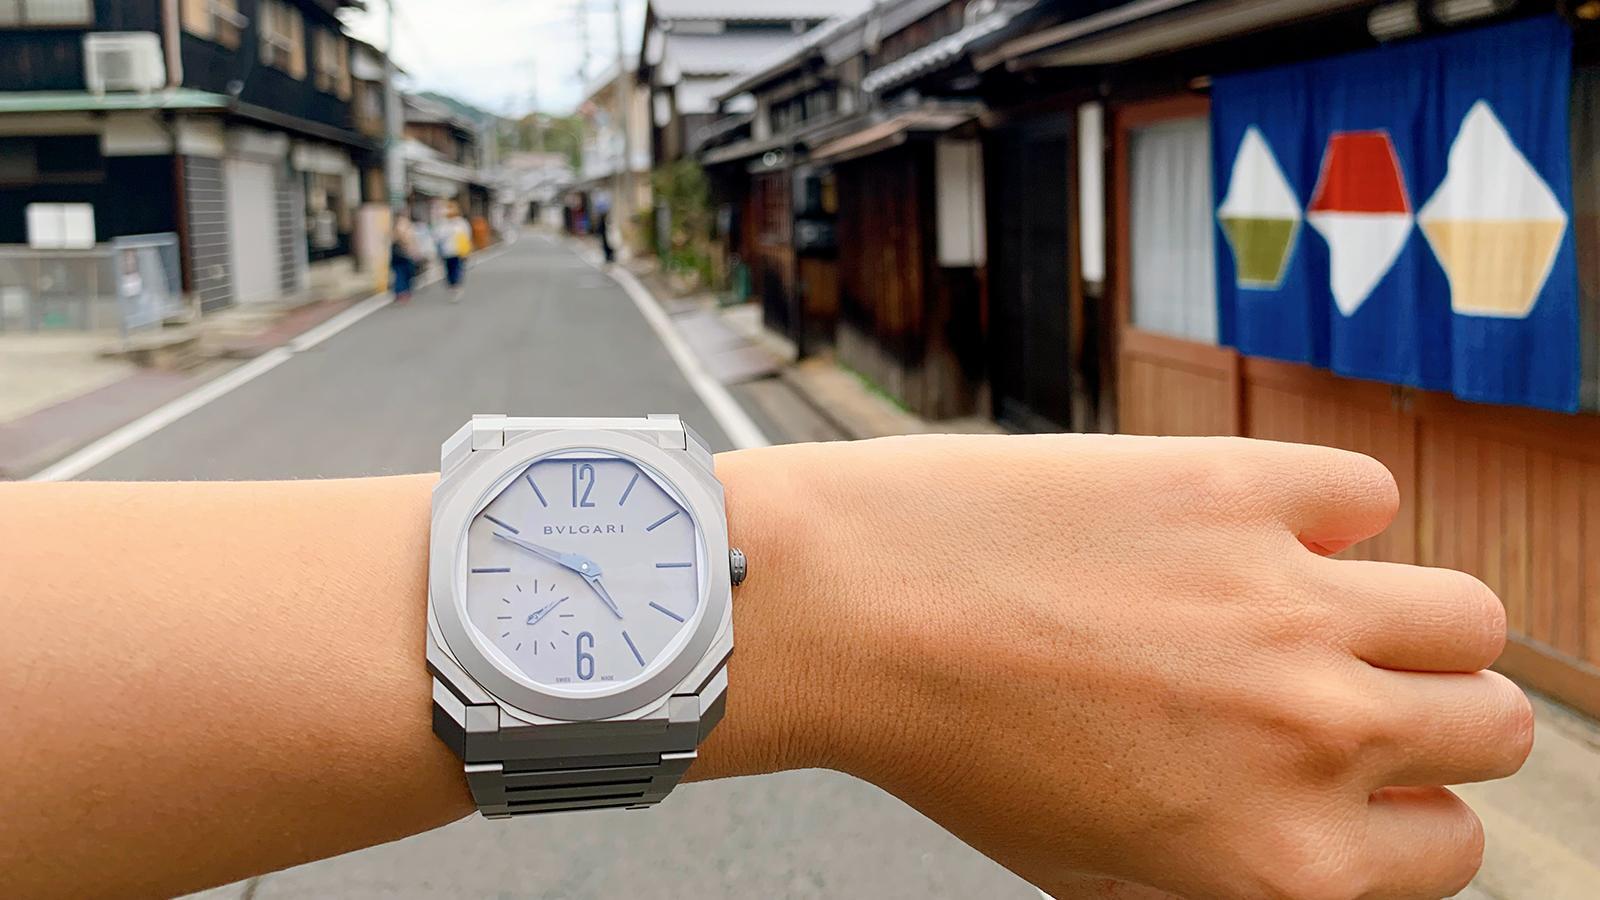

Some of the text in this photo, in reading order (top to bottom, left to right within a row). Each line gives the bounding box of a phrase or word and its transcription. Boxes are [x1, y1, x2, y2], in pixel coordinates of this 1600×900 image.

[572, 463, 595, 508] 12
[543, 524, 624, 535] BVLGARI
[576, 631, 594, 681] 6
